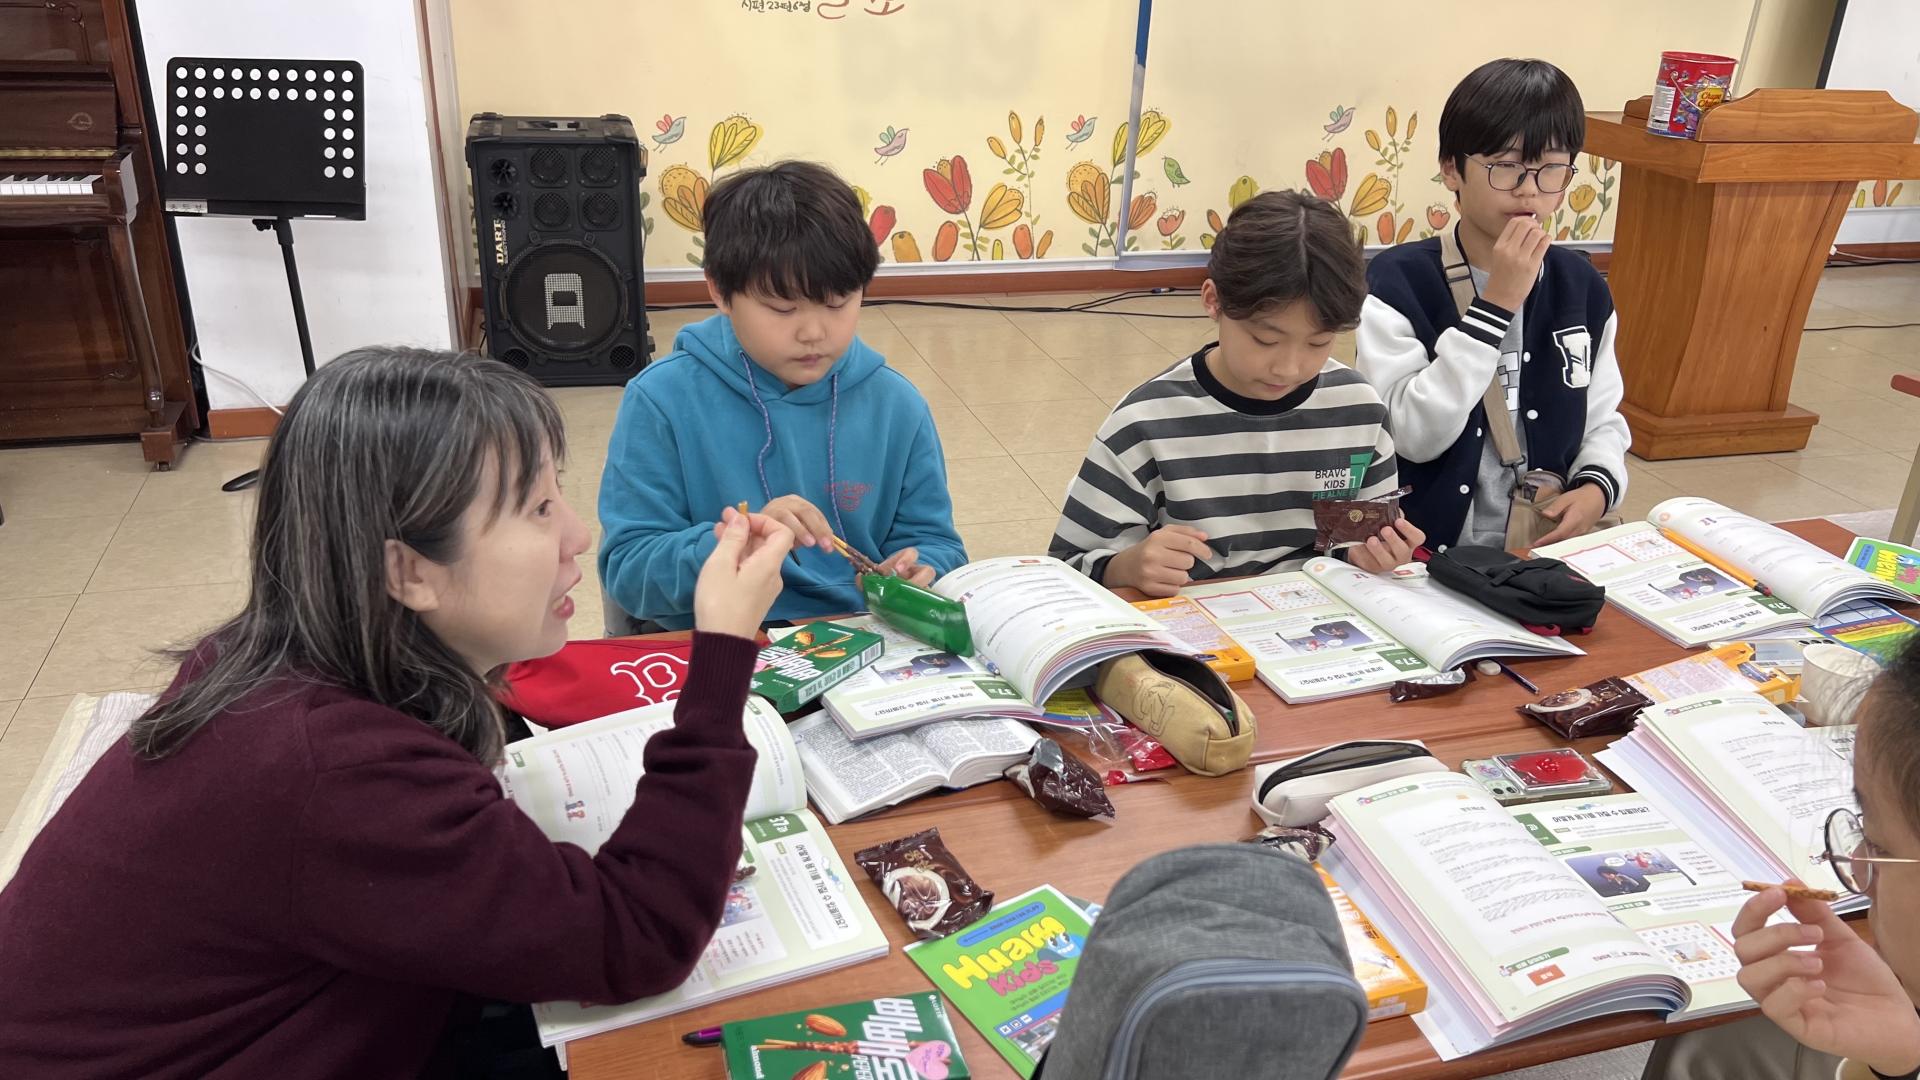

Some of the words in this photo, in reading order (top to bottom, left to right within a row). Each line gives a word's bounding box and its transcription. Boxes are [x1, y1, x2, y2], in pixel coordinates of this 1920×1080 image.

[493, 219, 504, 264] DART
[1324, 480, 1346, 489] KIDS
[942, 915, 1066, 989] Huam
[986, 959, 1060, 996] Kids
